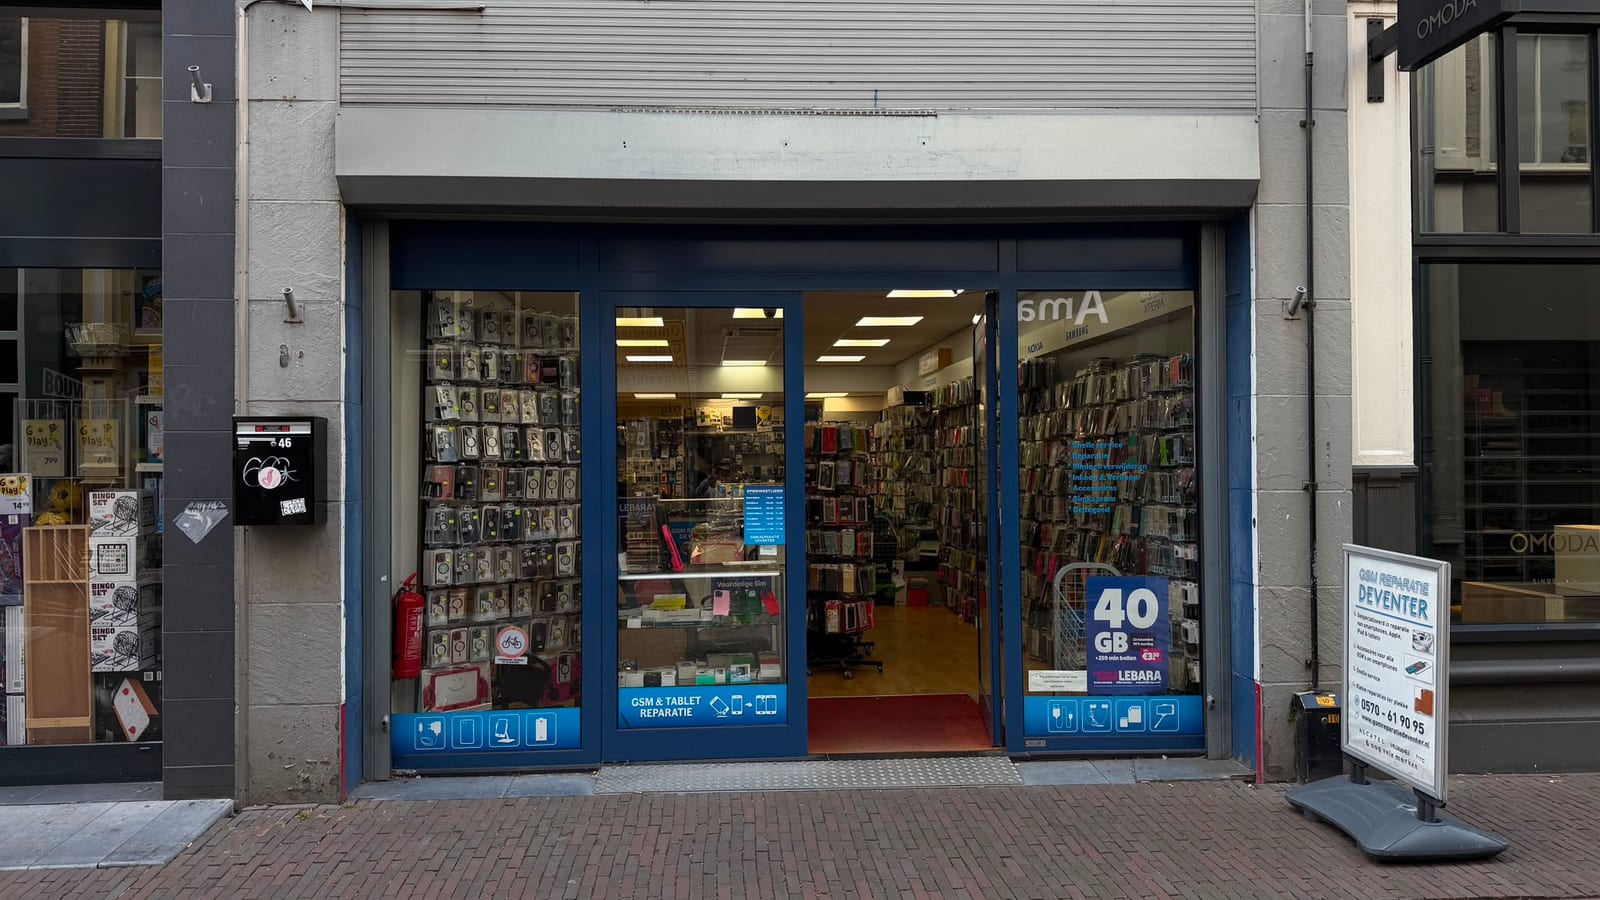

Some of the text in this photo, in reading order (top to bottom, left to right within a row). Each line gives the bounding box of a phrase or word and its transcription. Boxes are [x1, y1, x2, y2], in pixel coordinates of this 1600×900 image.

[1417, 0, 1476, 39] OMODA
[1027, 341, 1044, 354] NOKIA
[278, 438, 292, 448] 46
[1510, 533, 1599, 554] OMODA
[1359, 568, 1429, 596] GSM REPARATIE
[1094, 588, 1159, 629] 40
[1359, 584, 1428, 620] DEVENTER
[1094, 632, 1128, 653] GB
[1118, 670, 1162, 681] LEBARA
[631, 696, 701, 708] GSM & TABLET
[640, 708, 693, 718] REPARATIE
[1361, 698, 1380, 716] 0570
[1388, 710, 1397, 724] 61
[1400, 715, 1410, 729] 90
[1413, 720, 1425, 735] 95
[1359, 728, 1385, 744] ALCATEL
[1395, 754, 1418, 770] merken
